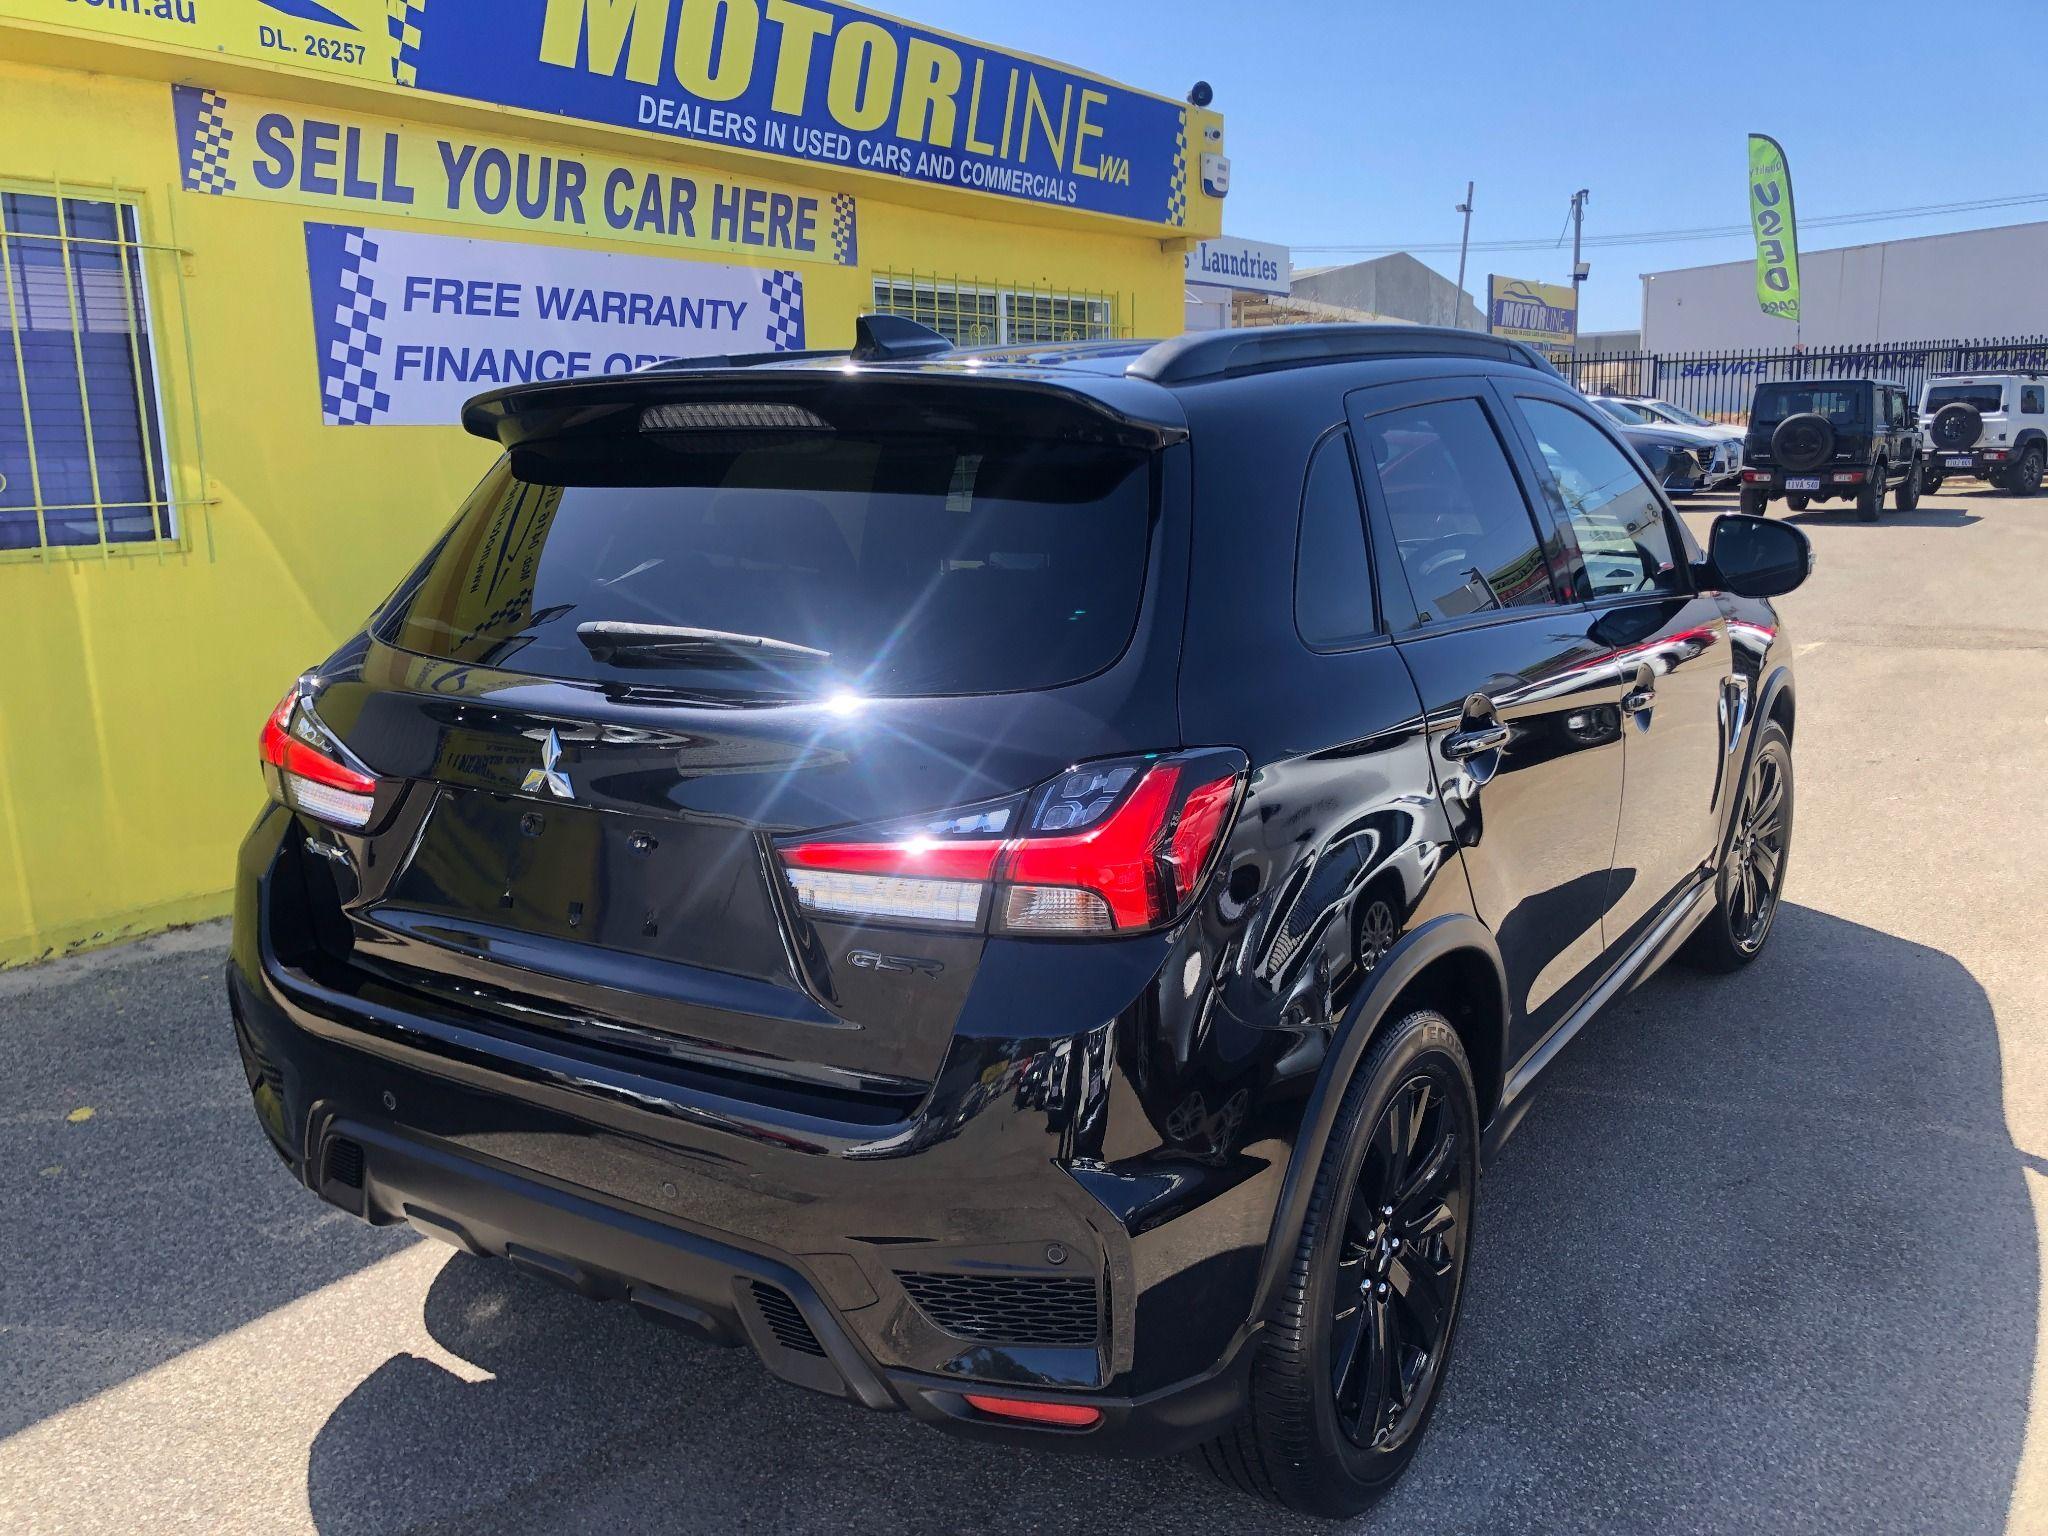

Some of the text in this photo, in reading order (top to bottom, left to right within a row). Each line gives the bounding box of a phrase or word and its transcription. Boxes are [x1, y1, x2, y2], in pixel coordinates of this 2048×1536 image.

[259, 25, 366, 66] DL. 26257
[637, 95, 1077, 203] DEALERS IN USED CARS AND COMMERCIALS
[252, 113, 819, 252] SELL YOUR CAR HERE
[1201, 242, 1278, 281] Laundries
[403, 276, 747, 331] FREE WARRANTY
[1501, 301, 1566, 332] MOTORLINE
[394, 345, 591, 383] FINANCE
